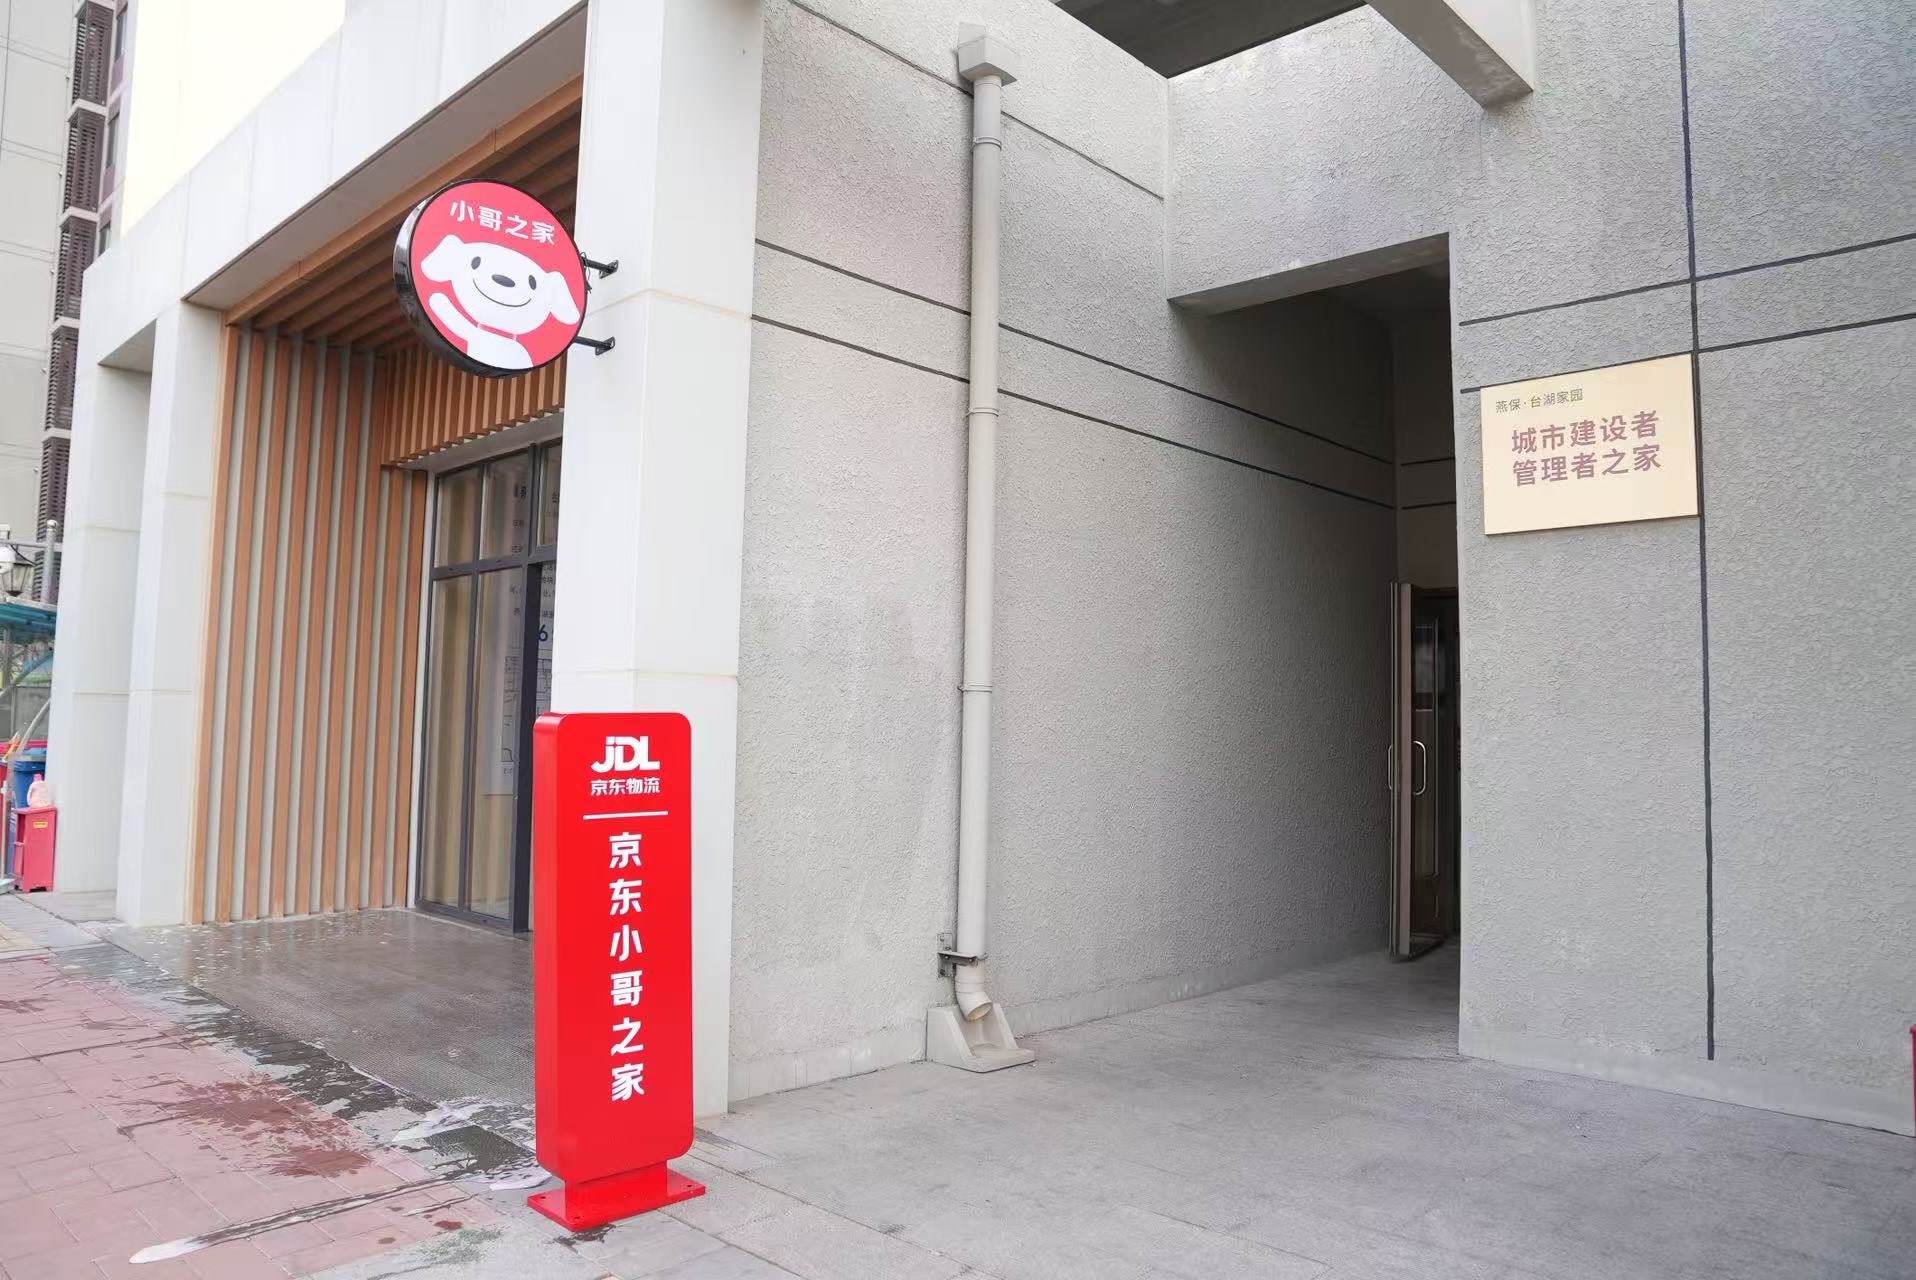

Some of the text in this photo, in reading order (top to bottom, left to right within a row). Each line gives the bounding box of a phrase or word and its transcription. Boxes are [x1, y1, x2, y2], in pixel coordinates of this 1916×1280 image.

[450, 200, 555, 246] 小哥之家
[1495, 388, 1584, 414] 燕保·台湖家园
[1512, 410, 1659, 454] 城市建设者
[1513, 444, 1662, 487] 管理者之家
[591, 736, 660, 773] JDL
[590, 777, 660, 796] 京东物流
[609, 832, 645, 1101] 京东小哥之家
